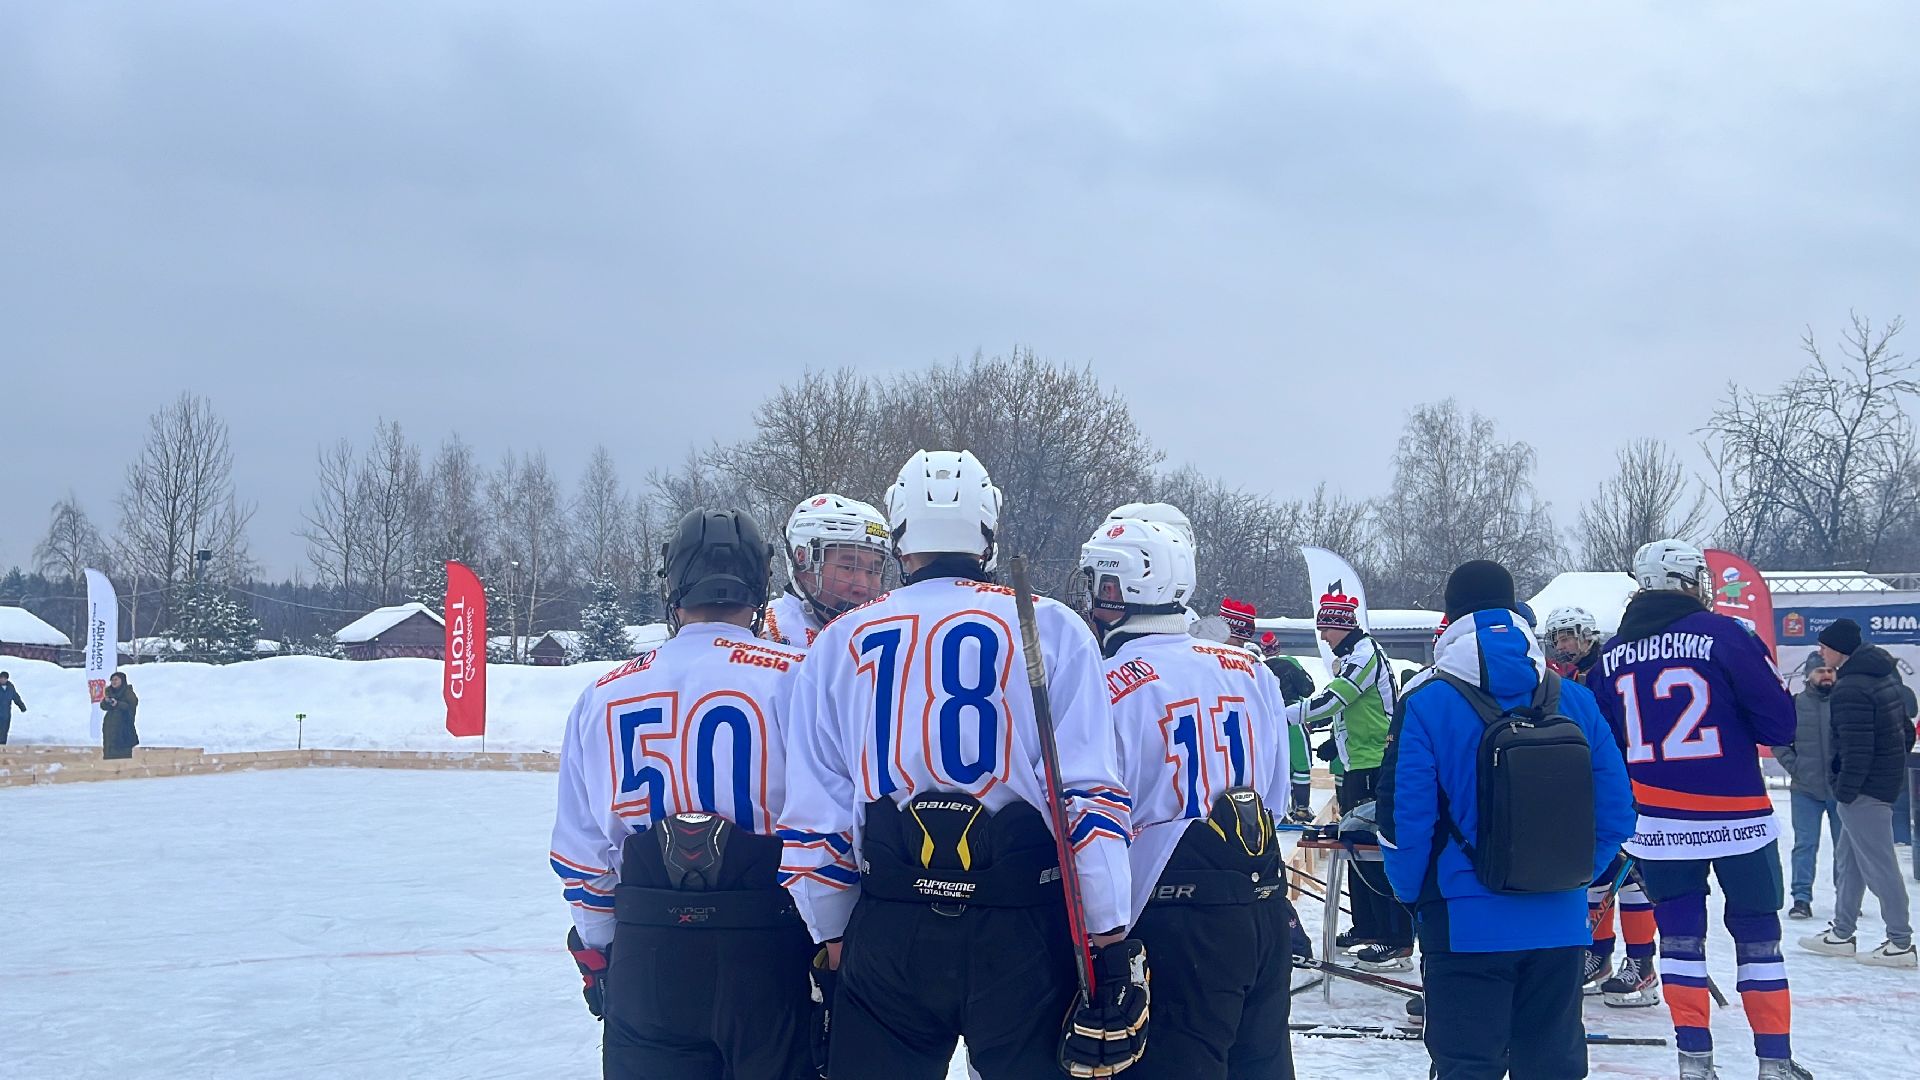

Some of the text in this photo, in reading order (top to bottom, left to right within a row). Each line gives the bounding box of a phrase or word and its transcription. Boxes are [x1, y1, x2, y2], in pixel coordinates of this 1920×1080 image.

[1870, 615, 1920, 630] ЗИМ
[729, 648, 789, 673] Russia
[849, 610, 1014, 800] 18
[1615, 666, 1724, 764] 12
[607, 690, 772, 835] 50
[1160, 696, 1255, 818] 11
[914, 801, 974, 813] BAUER
[1666, 826, 1731, 847] ГОРОДСКОЙ
[1733, 823, 1767, 841] ОКРУГ
[913, 879, 976, 892] SUPREME
